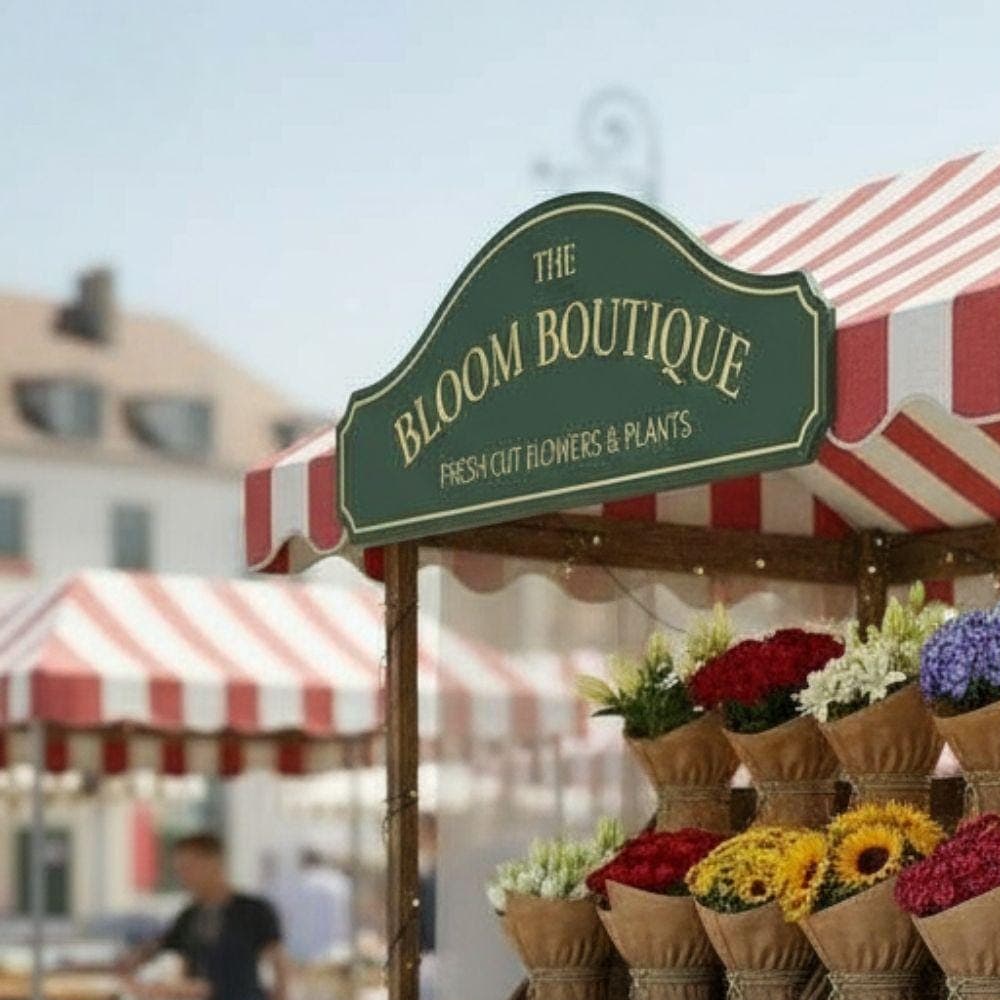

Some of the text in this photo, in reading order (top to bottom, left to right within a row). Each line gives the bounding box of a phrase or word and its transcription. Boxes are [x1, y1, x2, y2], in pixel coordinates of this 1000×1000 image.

[533, 243, 577, 283] THE
[393, 297, 751, 468] BLOOM BOUTIQUE
[440, 453, 488, 489] FRESH
[490, 446, 522, 477] CUT
[606, 425, 620, 454] &
[624, 409, 692, 450] PLANTS
